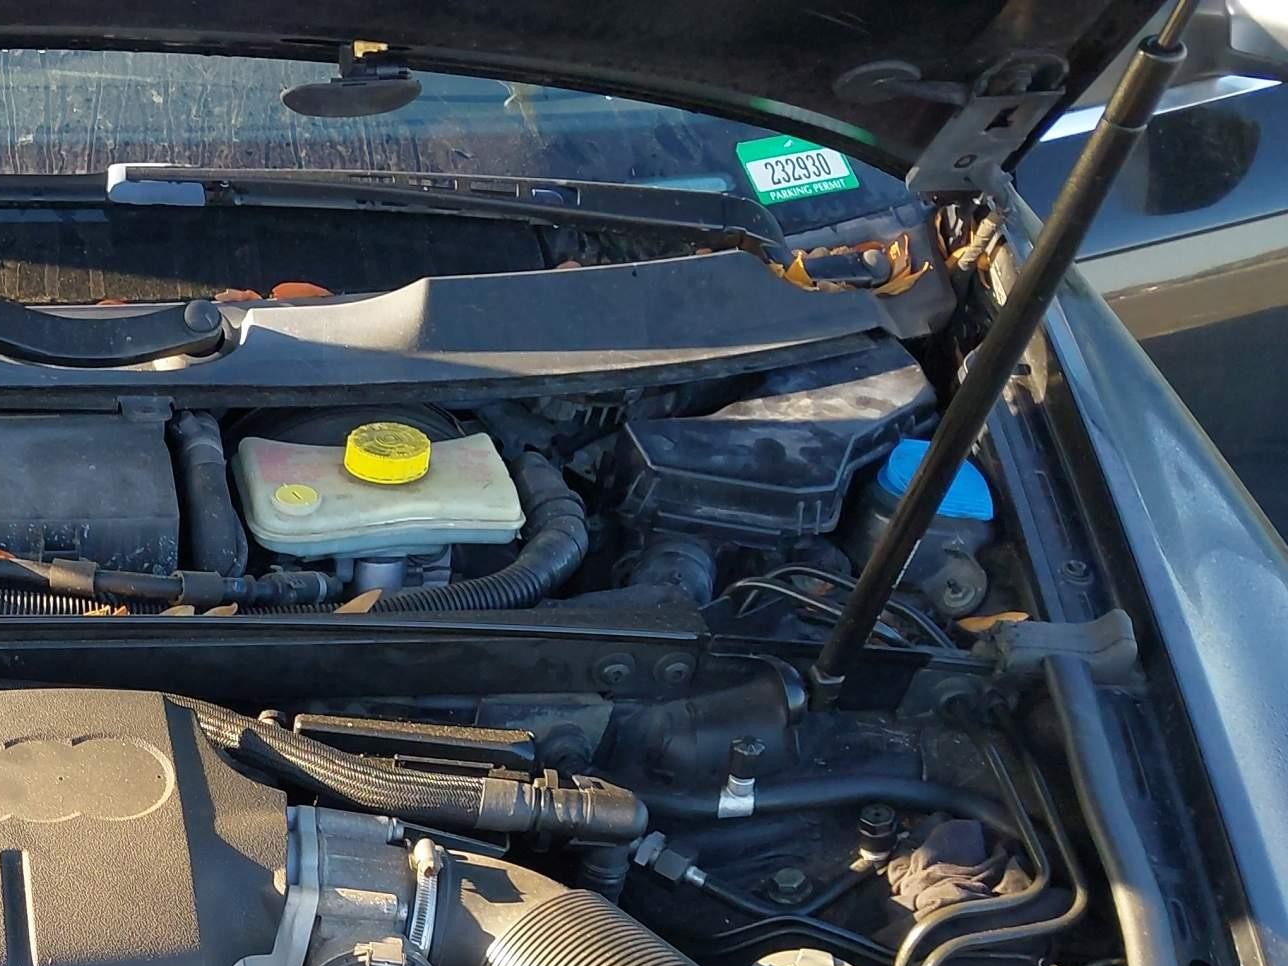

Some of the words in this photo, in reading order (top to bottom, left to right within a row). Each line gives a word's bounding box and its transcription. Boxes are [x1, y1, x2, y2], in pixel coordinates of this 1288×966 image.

[765, 152, 832, 185] 232930
[769, 183, 812, 201] PARKING
[813, 179, 846, 193] PERMIT
